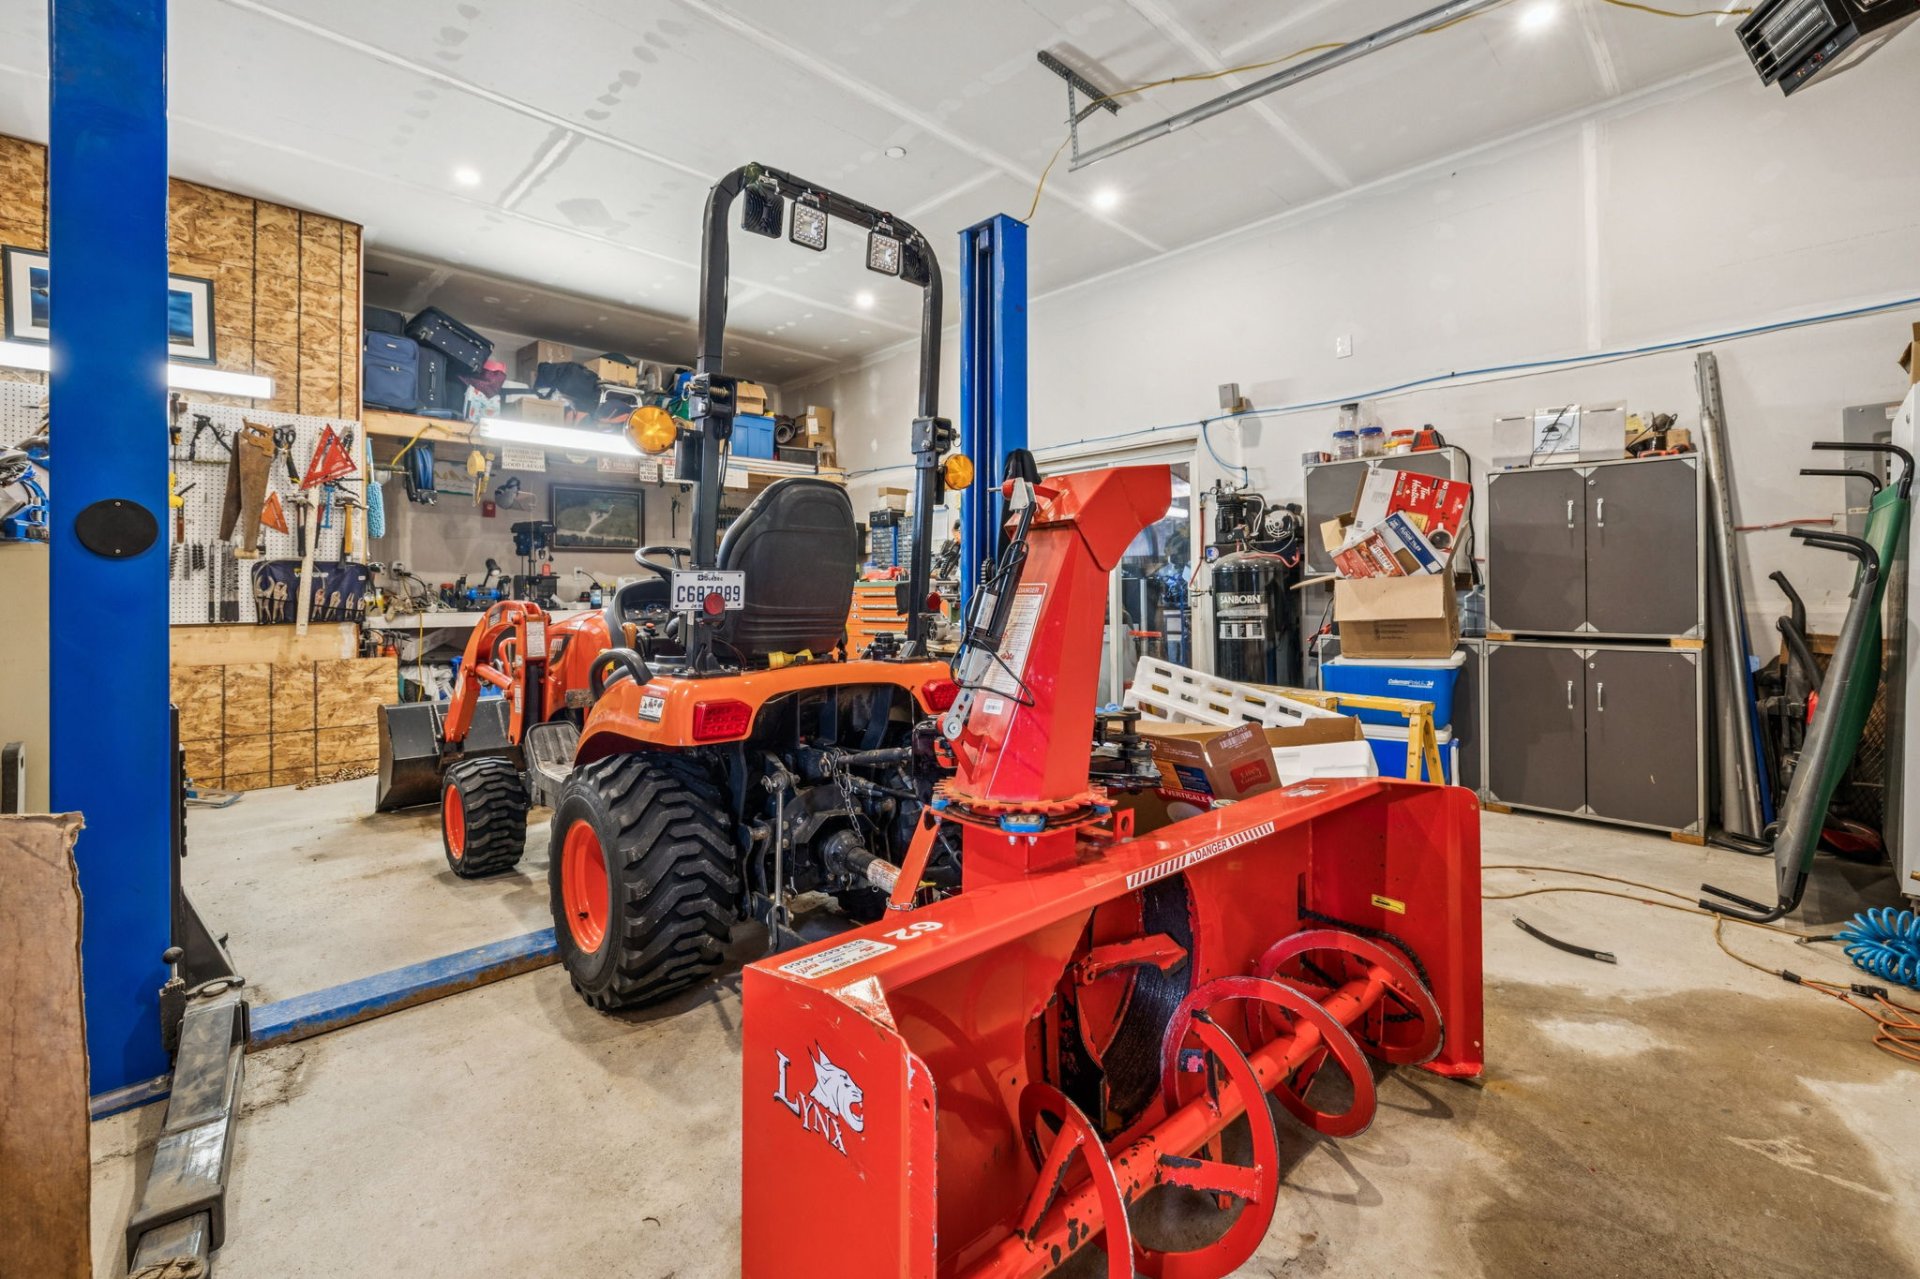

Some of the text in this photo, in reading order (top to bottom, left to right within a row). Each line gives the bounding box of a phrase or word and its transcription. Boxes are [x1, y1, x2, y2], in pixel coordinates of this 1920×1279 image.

[1410, 479, 1422, 507] Hortons
[1419, 485, 1431, 500] Tim
[1220, 594, 1261, 604] SANBORN
[1195, 839, 1229, 861] DANGER
[881, 921, 944, 941] 62
[773, 1047, 848, 1158] LYNX
